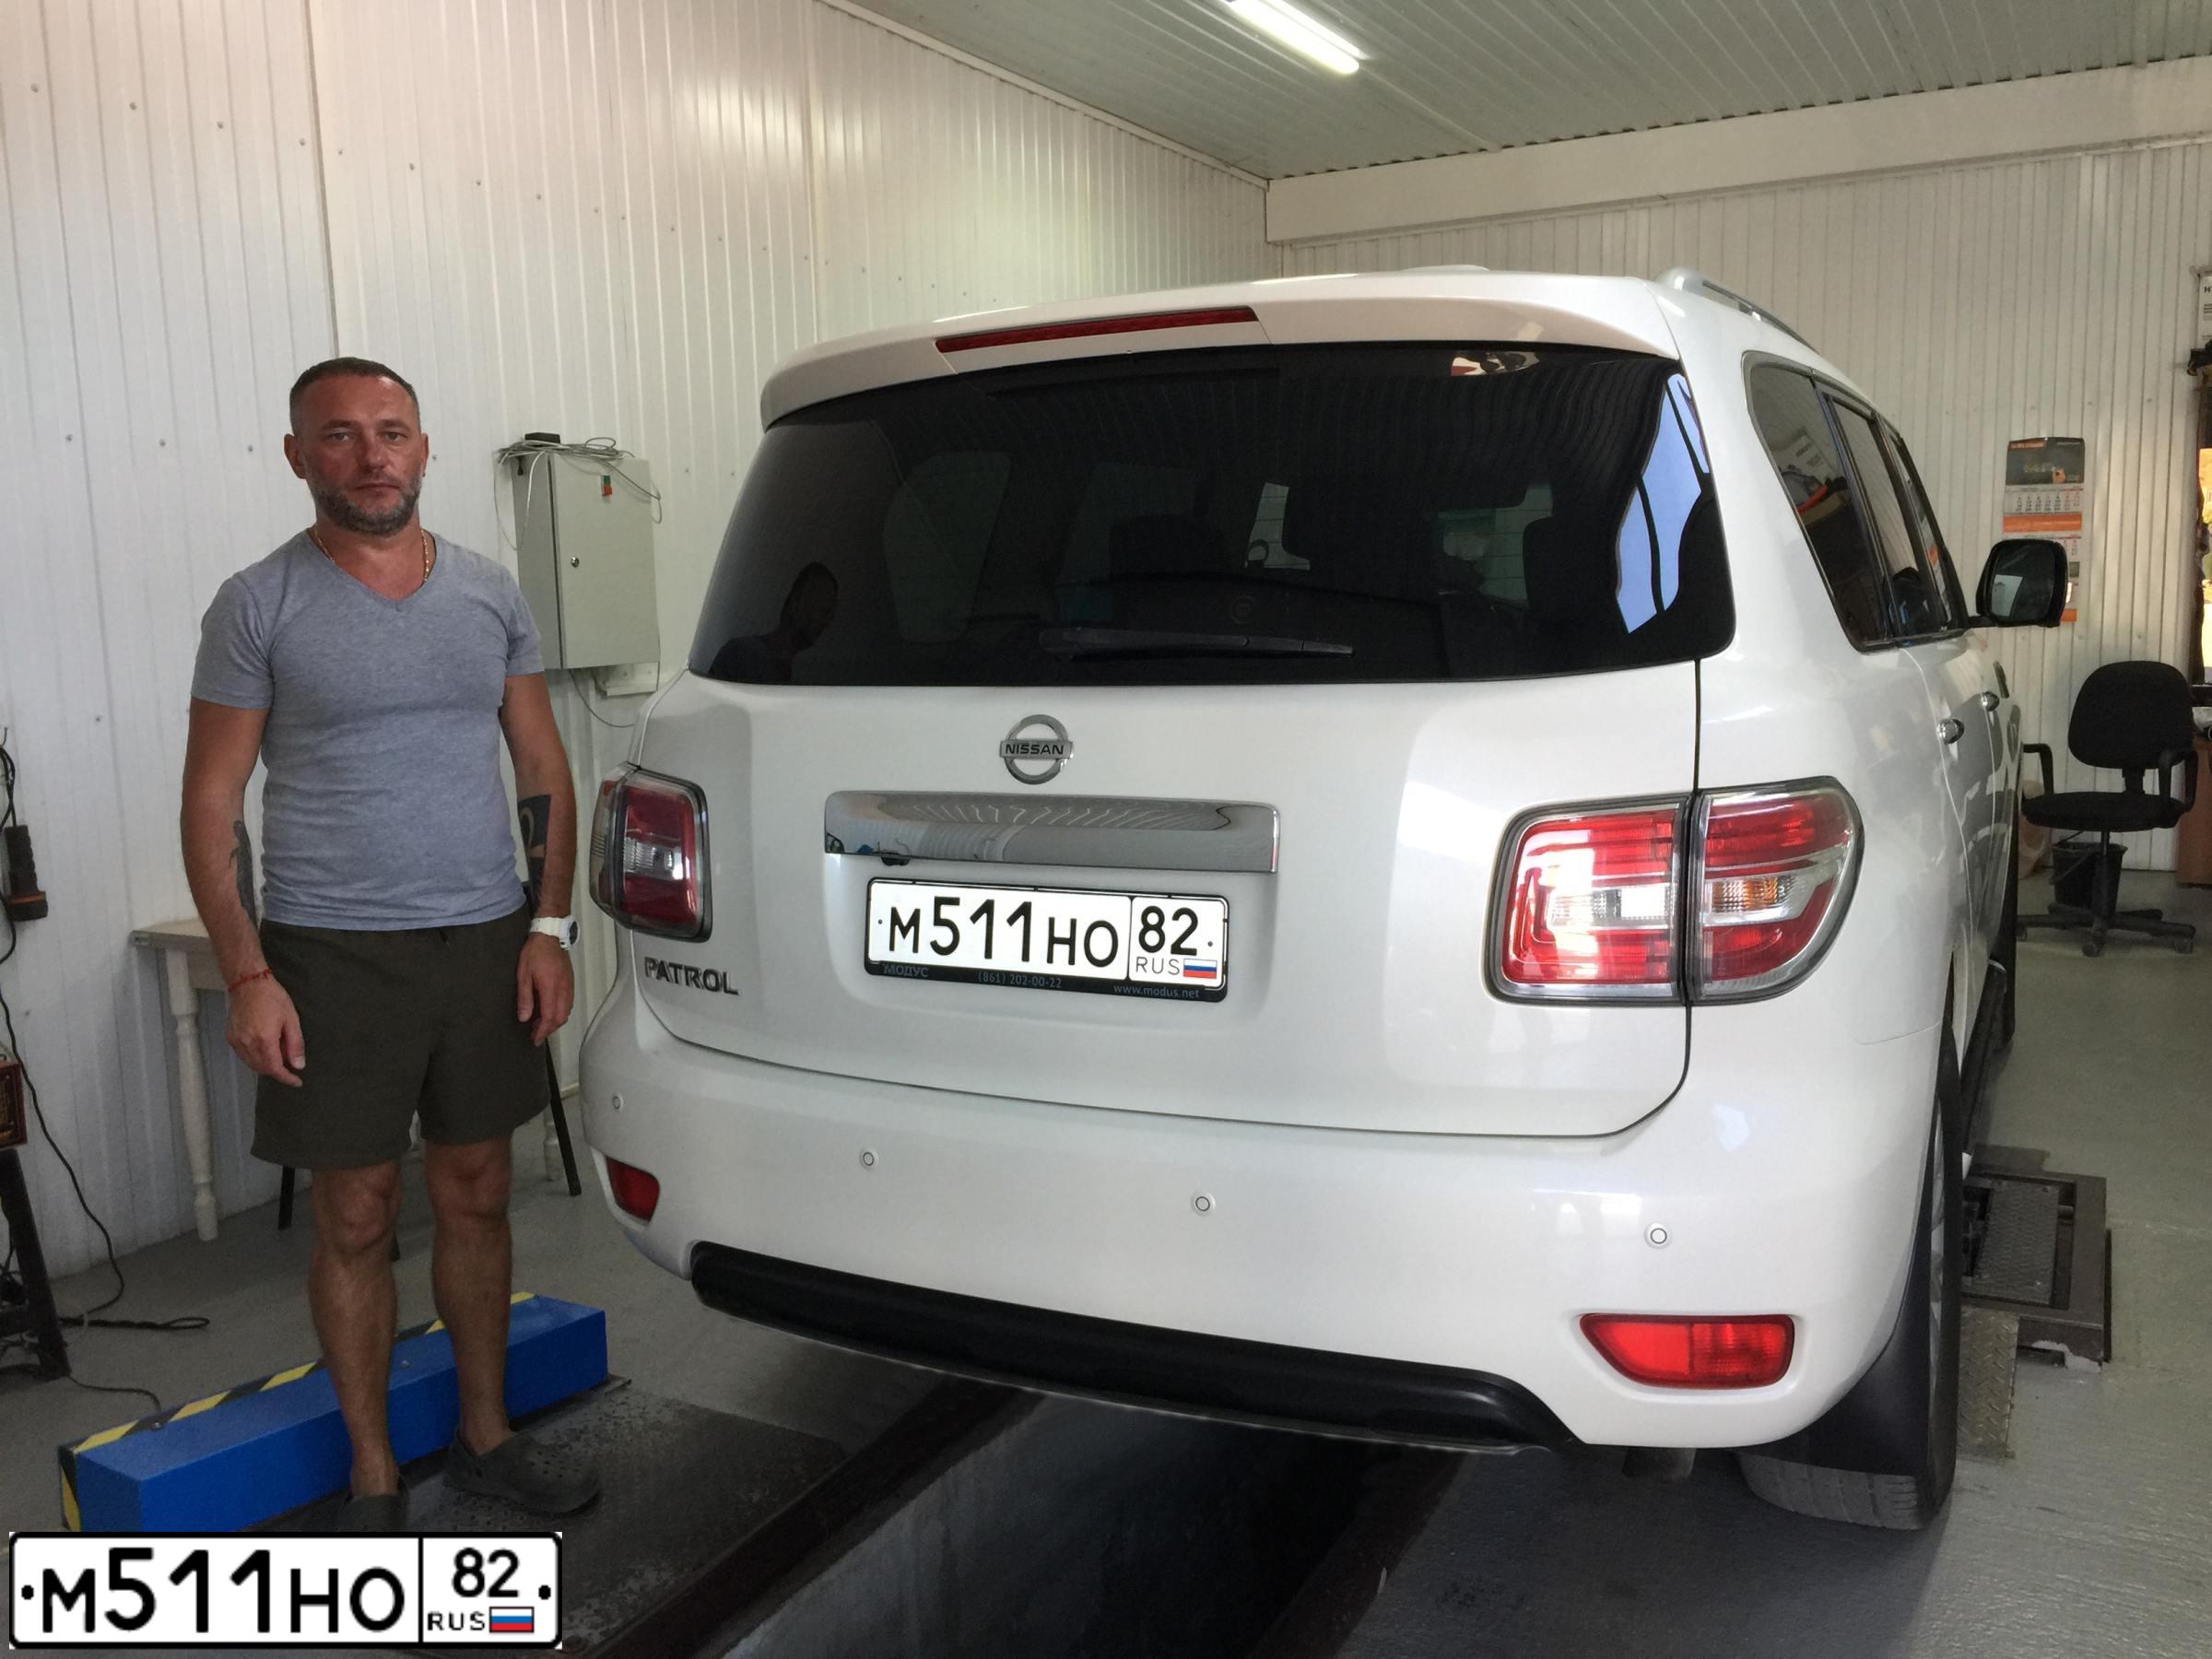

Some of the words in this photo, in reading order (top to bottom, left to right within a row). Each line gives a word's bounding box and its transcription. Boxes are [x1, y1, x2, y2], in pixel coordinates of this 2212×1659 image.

[1005, 743, 1065, 755] NISSAN
[1138, 905, 1199, 956] 82
[883, 963, 930, 978] МОДУС
[1135, 956, 1181, 975] RUS
[644, 956, 740, 995] PATROL
[978, 971, 1006, 984] (861)
[1009, 972, 1063, 990] 202-00-22
[1112, 983, 1201, 999] www.modus.net
